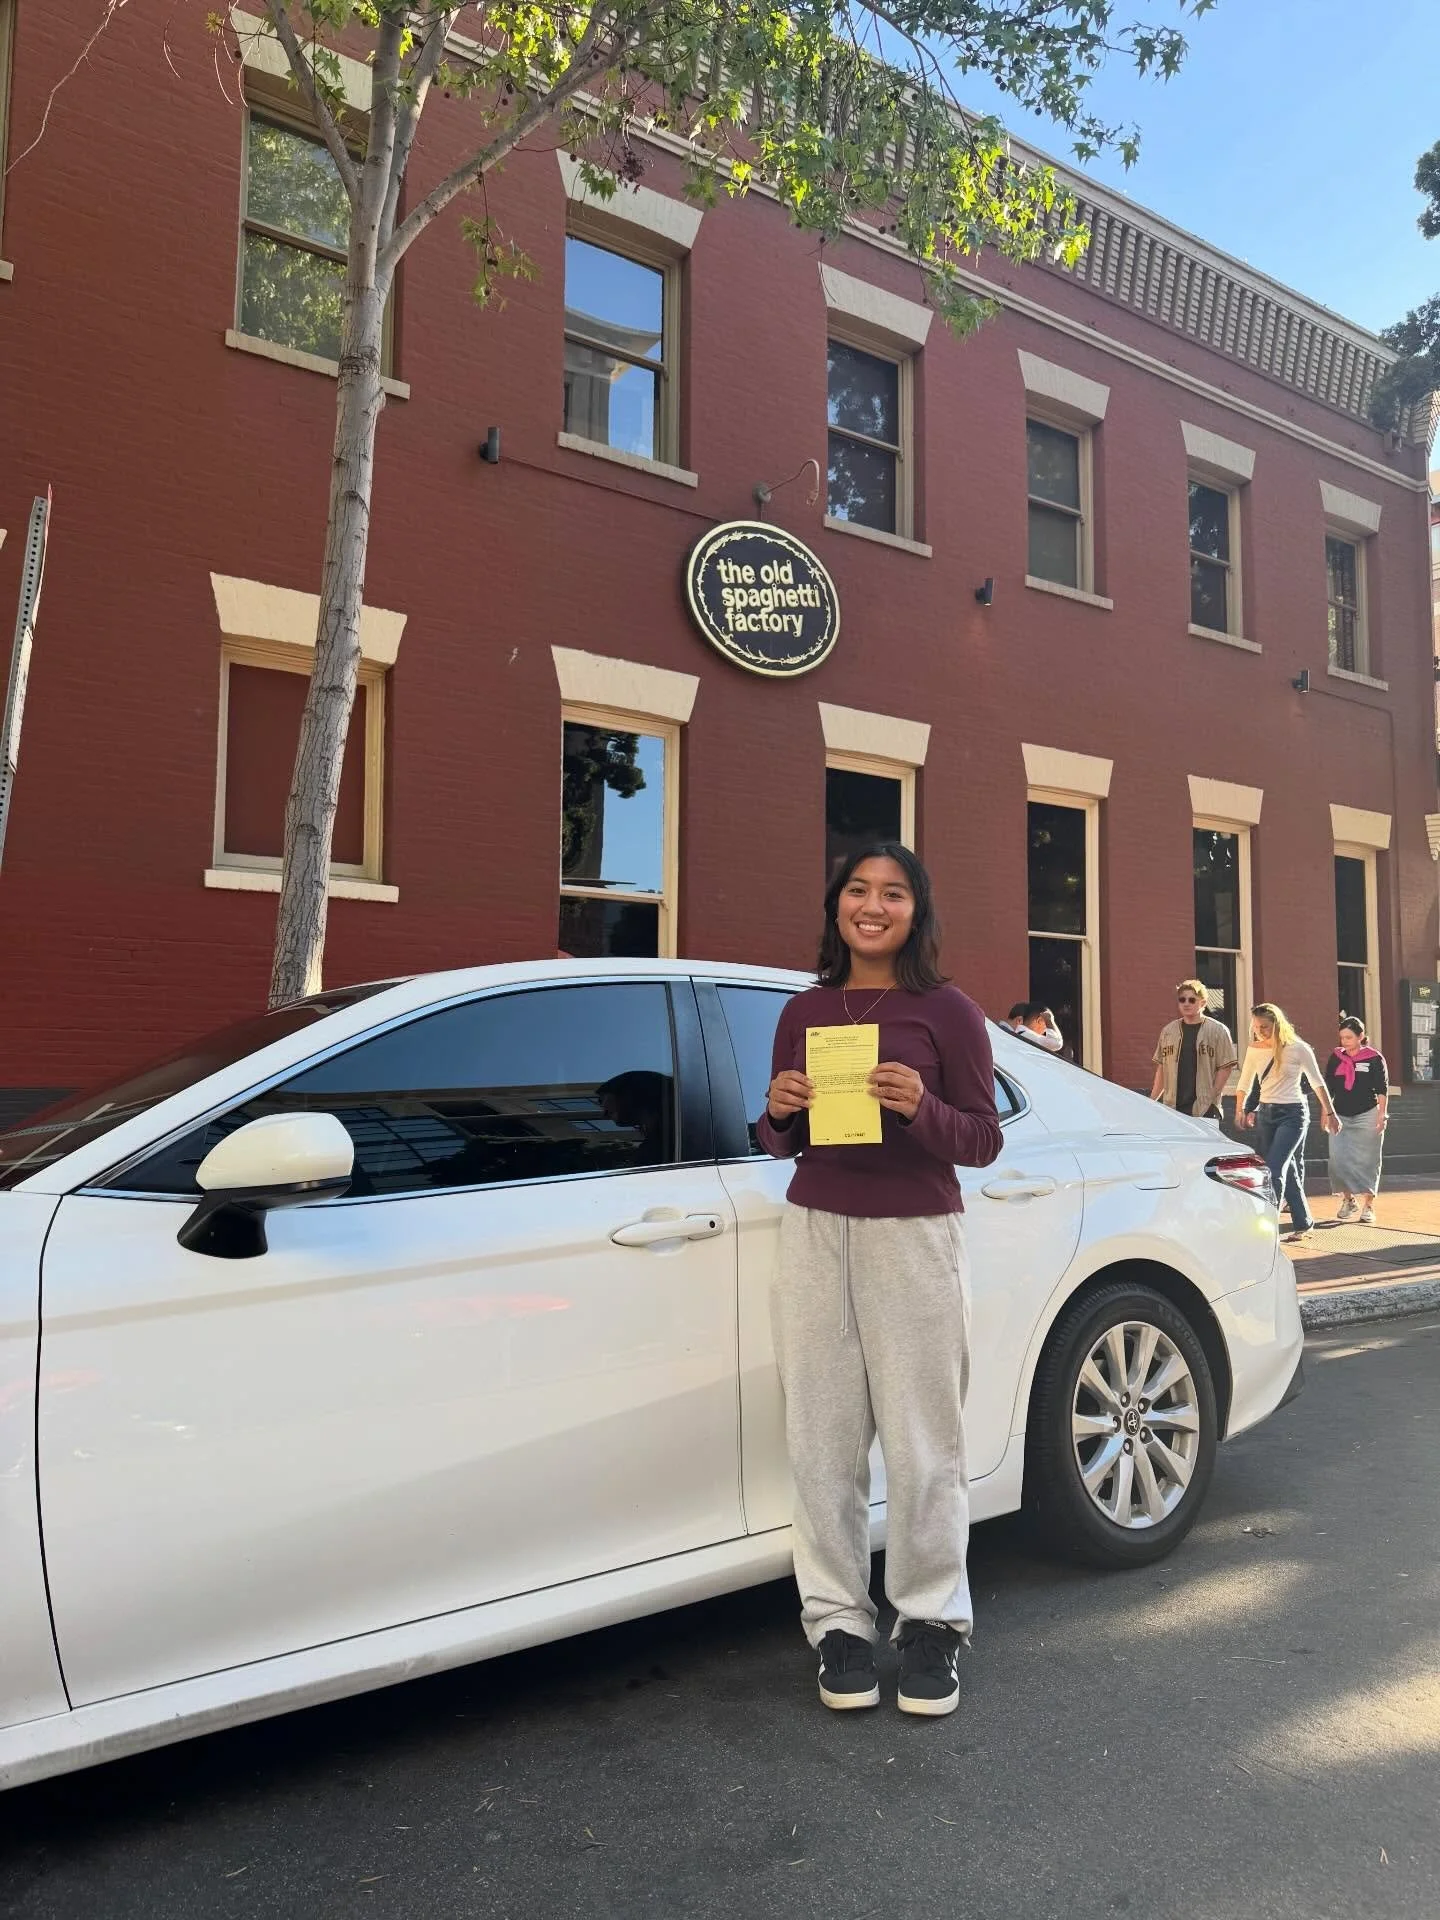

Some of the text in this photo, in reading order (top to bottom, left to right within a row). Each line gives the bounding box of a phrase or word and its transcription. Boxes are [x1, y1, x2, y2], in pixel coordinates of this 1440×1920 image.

[716, 557, 794, 585] the old
[721, 582, 821, 613] spaghetti
[725, 607, 804, 638] factory
